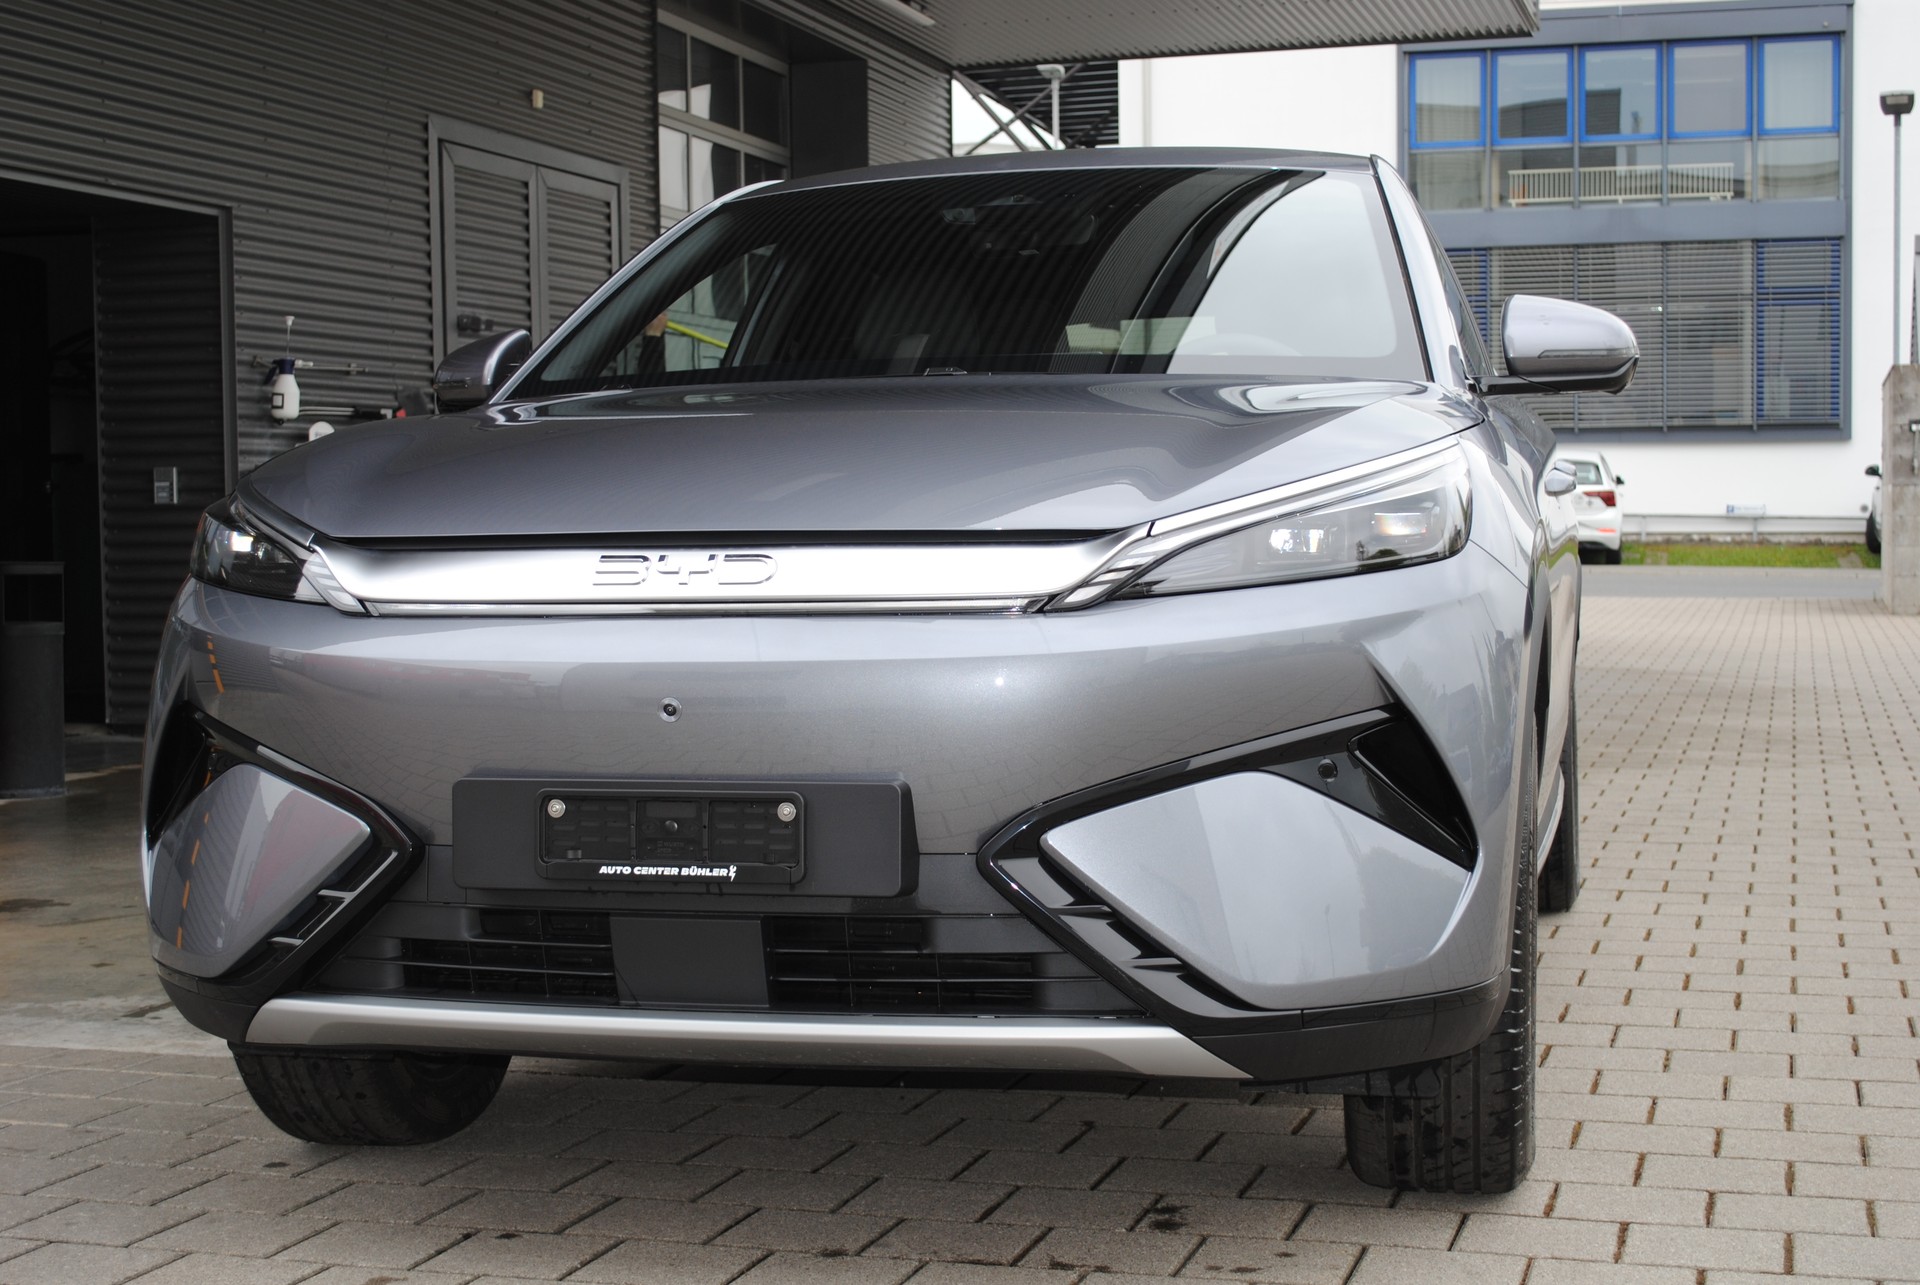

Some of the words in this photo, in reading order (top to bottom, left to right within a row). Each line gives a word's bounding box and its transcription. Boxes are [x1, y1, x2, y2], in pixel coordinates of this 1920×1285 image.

[592, 554, 778, 586] BYD
[599, 865, 632, 875] AUTO
[634, 866, 680, 876] CENTER
[680, 866, 729, 877] BÜHLER
